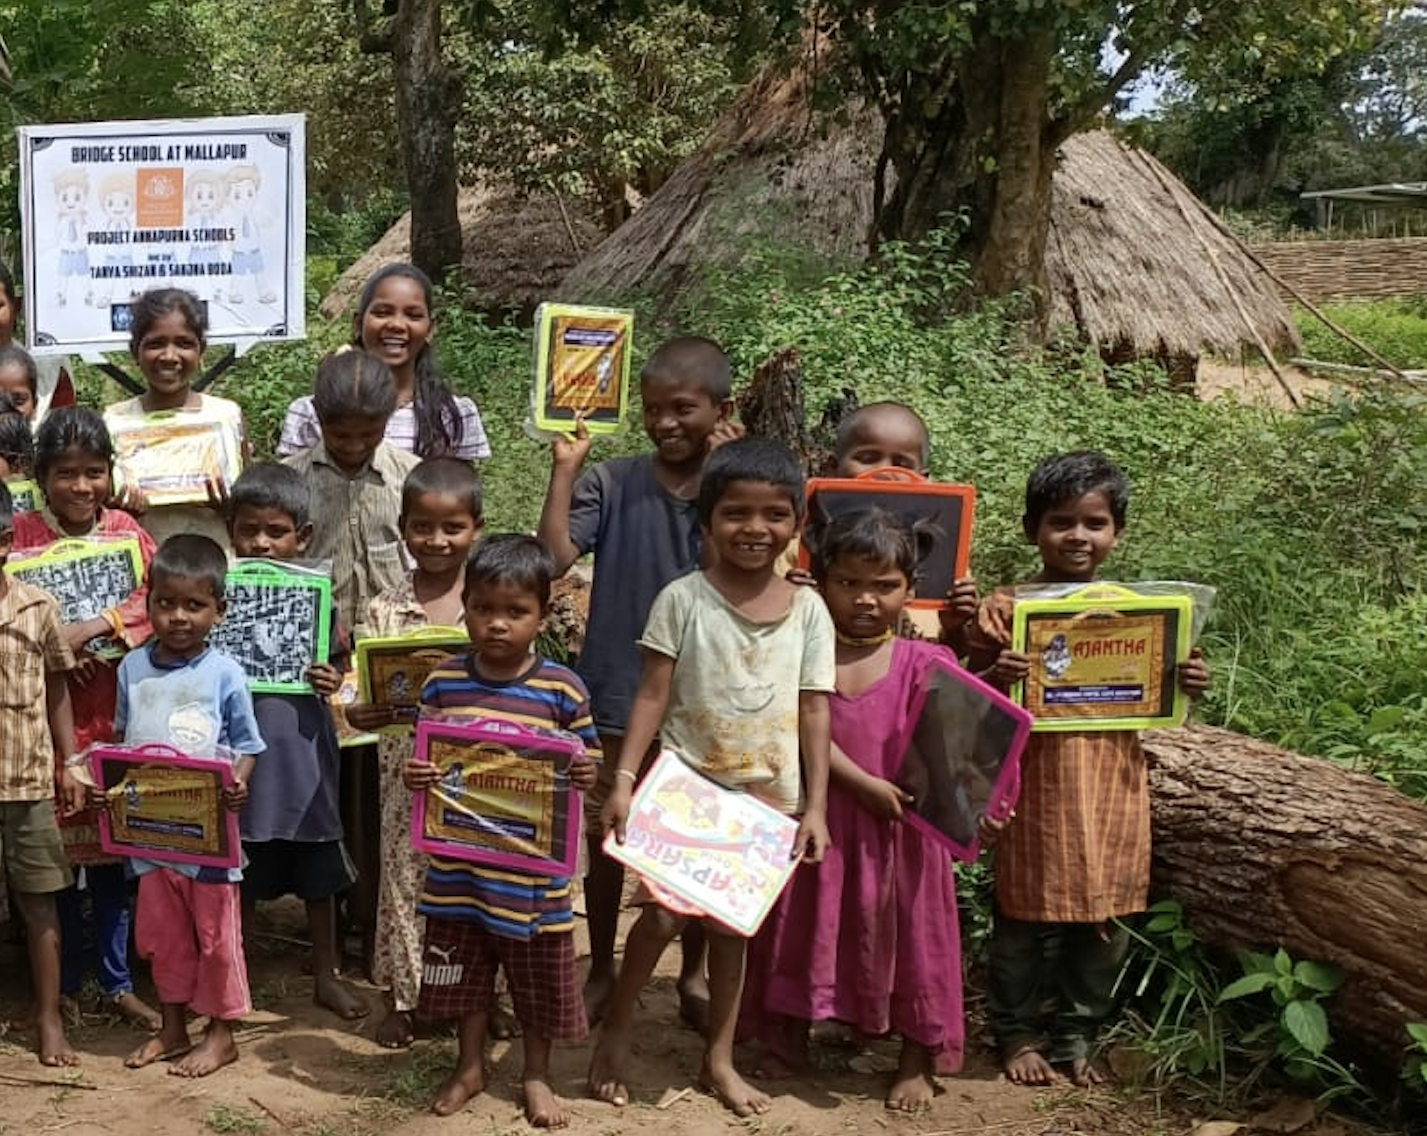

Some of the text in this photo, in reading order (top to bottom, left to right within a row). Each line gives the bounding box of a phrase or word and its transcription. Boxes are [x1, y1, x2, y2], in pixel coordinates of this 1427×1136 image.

[71, 143, 247, 163] BRIDGE SCHOOL AT MALLAPUR
[88, 228, 235, 245] PROJECT ANNAPURNA SCHOOLS
[1074, 638, 1146, 659] AJANTHA
[627, 825, 731, 891] APSARA
[423, 963, 465, 986] UMA
